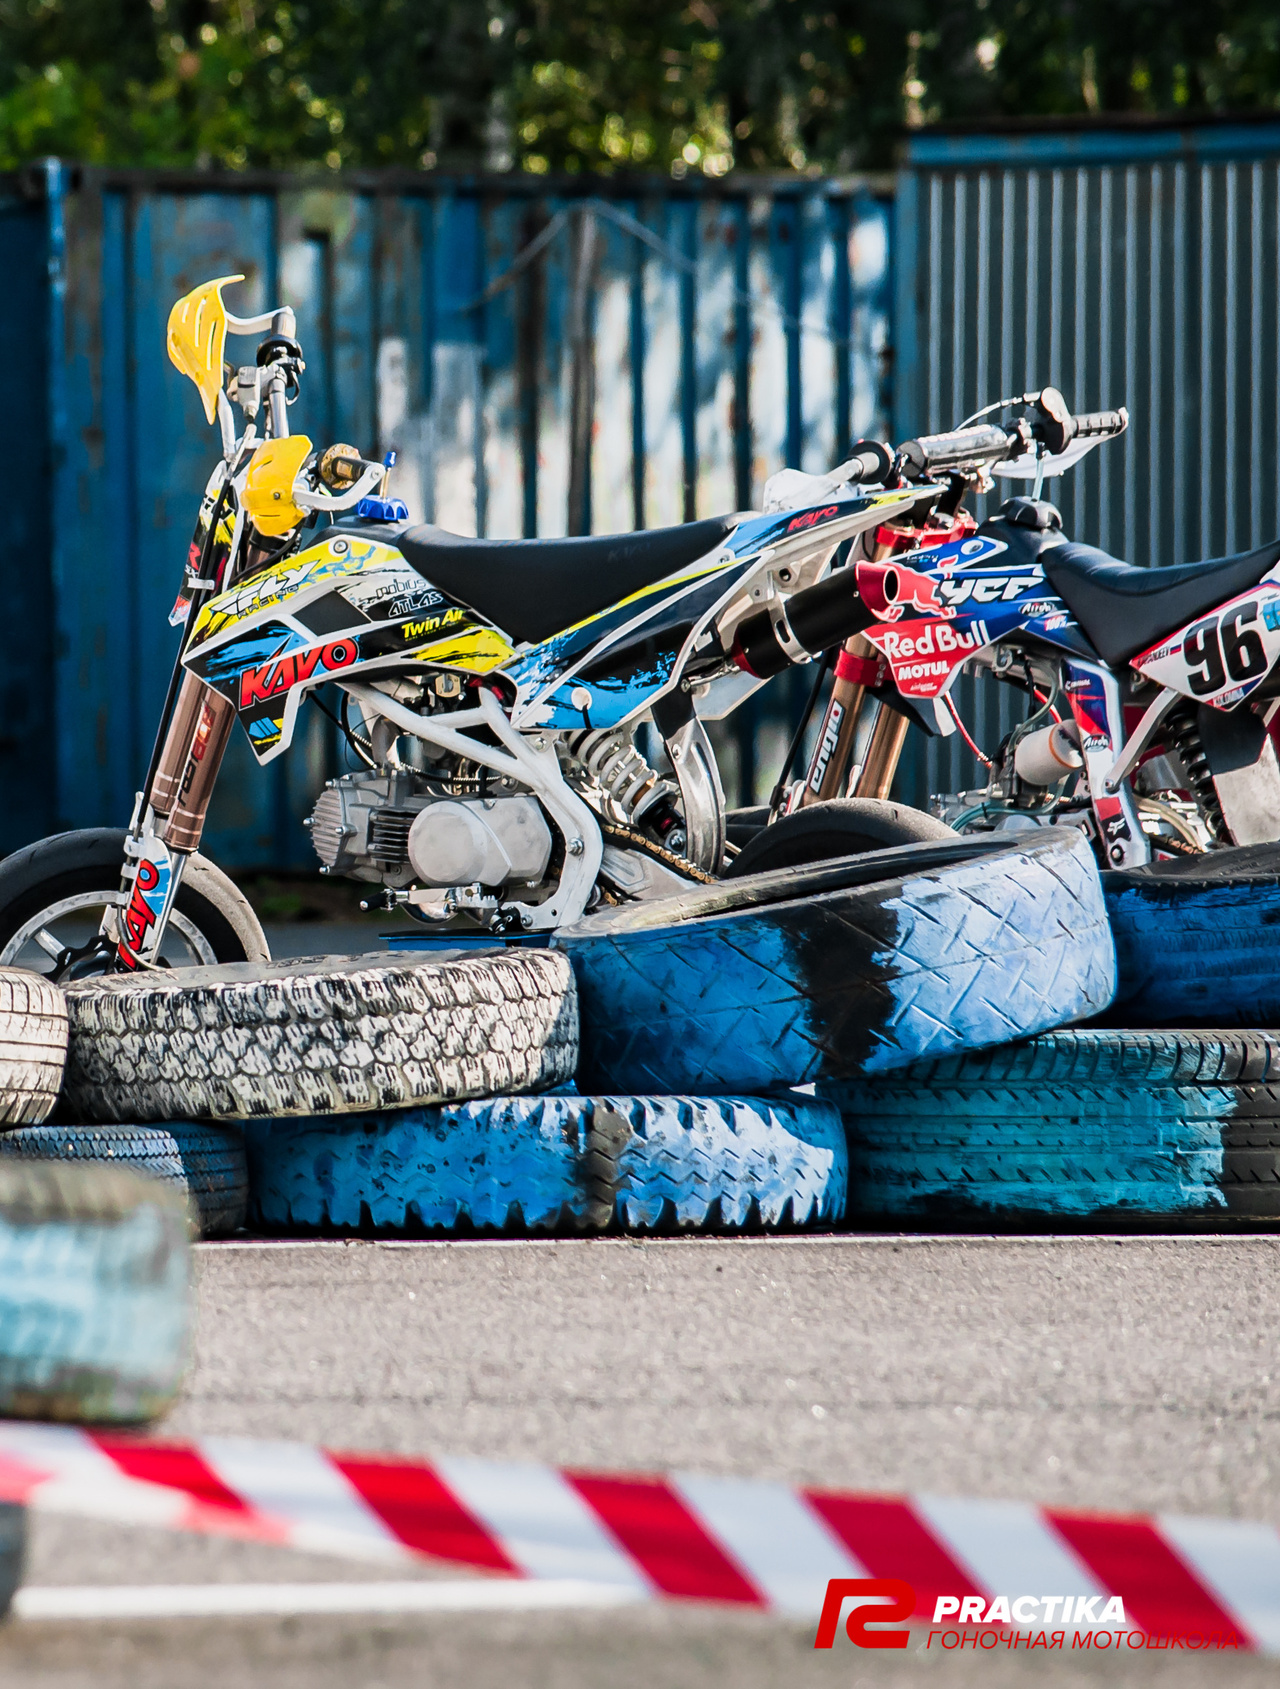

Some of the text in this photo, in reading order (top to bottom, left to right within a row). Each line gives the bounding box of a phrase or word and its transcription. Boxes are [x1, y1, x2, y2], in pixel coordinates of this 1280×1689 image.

[237, 584, 299, 620] RACING
[388, 591, 444, 618] ATLAS
[940, 576, 1044, 605] YCF
[401, 616, 440, 639] Twin
[441, 608, 465, 626] Air
[884, 619, 991, 659] Red Bull
[1183, 601, 1268, 696] 96
[898, 660, 950, 680] MOTUL
